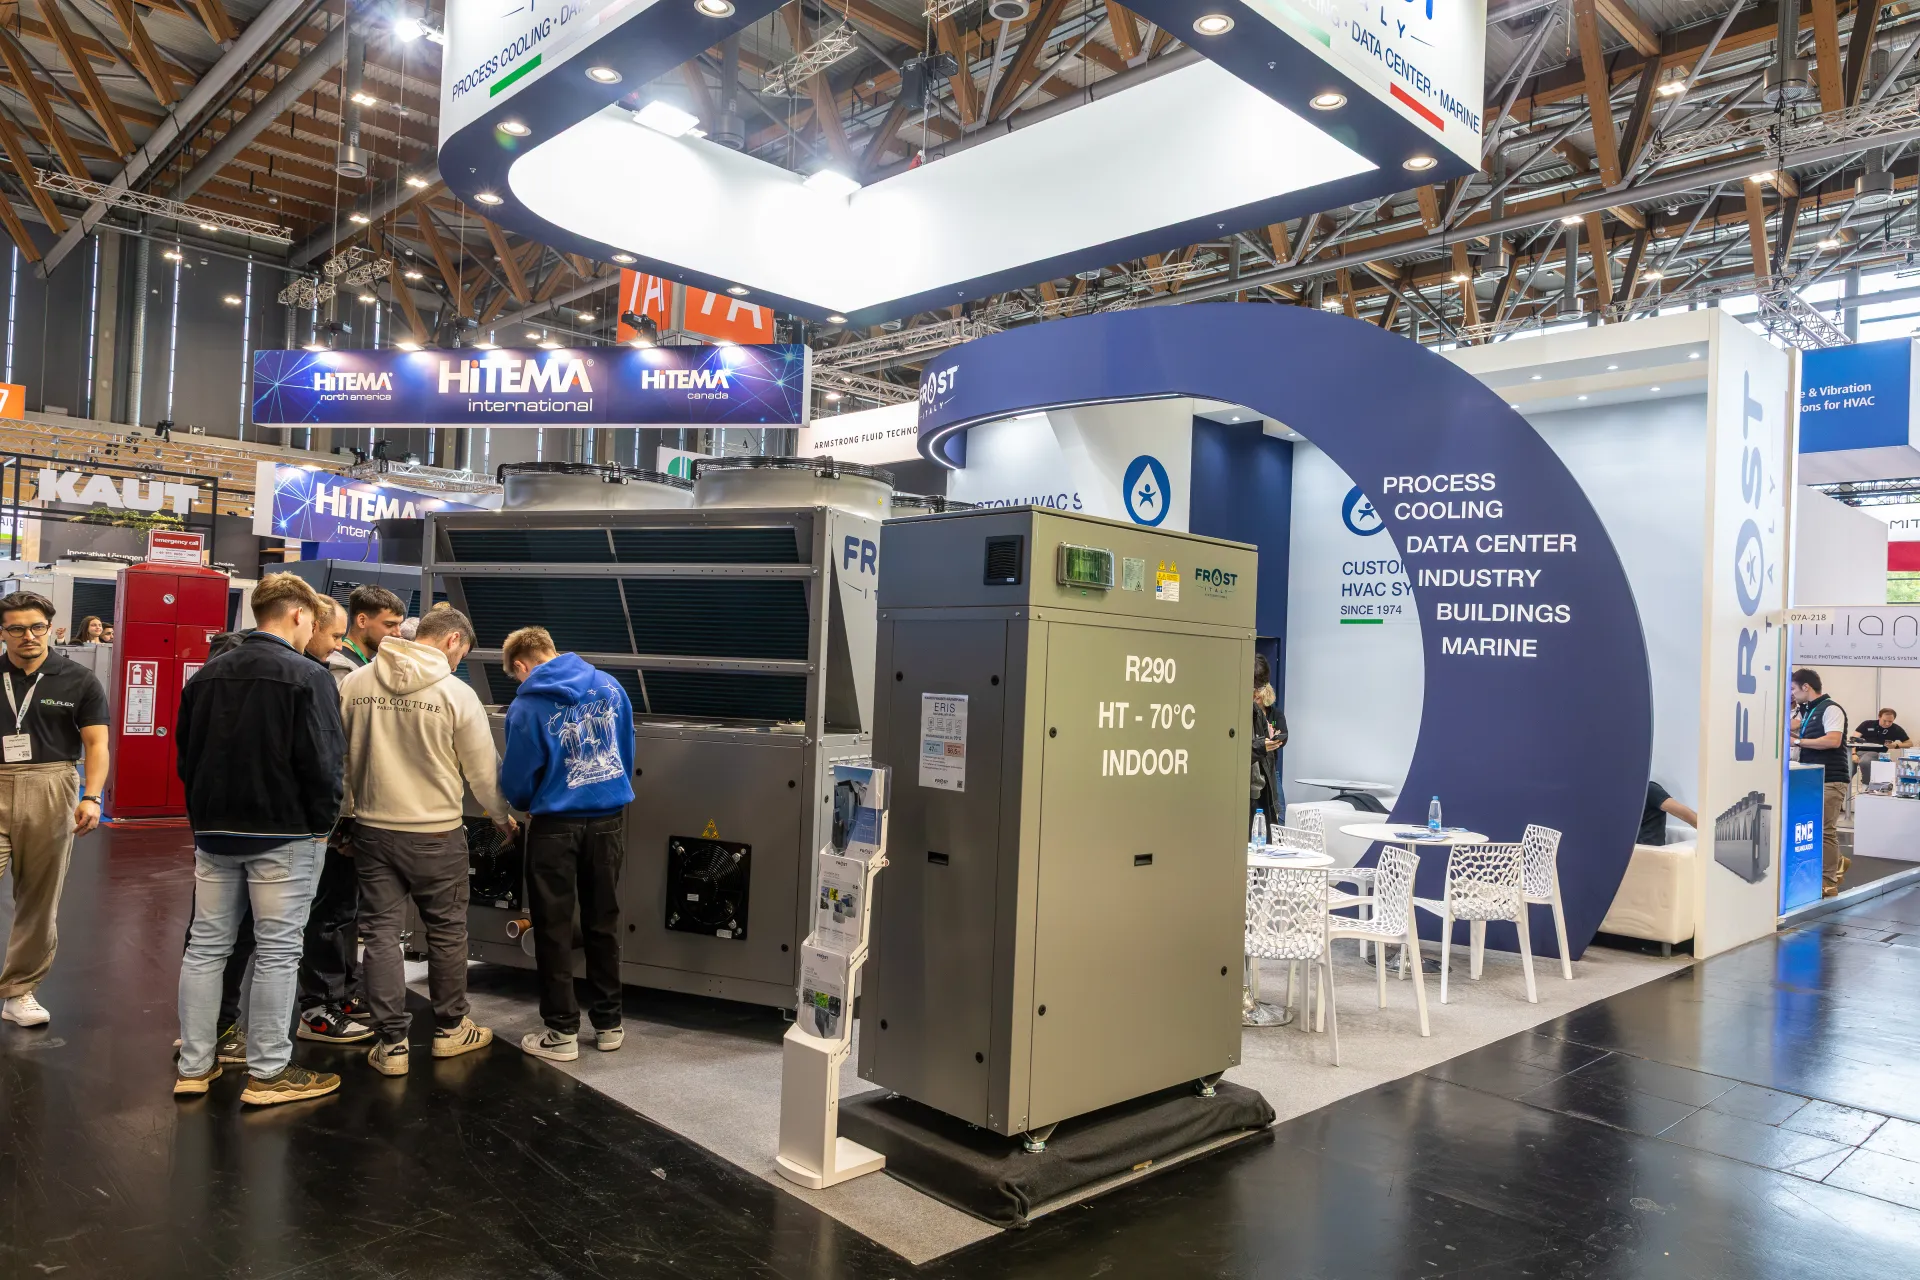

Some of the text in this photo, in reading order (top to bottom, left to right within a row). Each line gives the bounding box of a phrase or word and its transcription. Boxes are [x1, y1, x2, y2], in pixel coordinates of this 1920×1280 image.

[452, 56, 498, 102] PROCESS
[500, 17, 550, 67] COOLING
[1352, 20, 1382, 61] DATA
[1385, 48, 1431, 97] CENTER
[1440, 89, 1480, 134] MARINE
[321, 392, 391, 401] north america
[687, 391, 729, 400] canada
[1808, 388, 1817, 398] &
[1819, 383, 1872, 397] Vibration
[468, 398, 593, 412] international
[1824, 400, 1841, 411] for
[1843, 396, 1875, 409] HVAC
[814, 434, 859, 449] ARMSTRONG
[862, 431, 884, 443] FLUID
[38, 468, 199, 515] KAUT
[1383, 472, 1496, 494] PROCESS
[1394, 500, 1503, 520] COOLING
[154, 537, 188, 546] emergency
[1406, 534, 1577, 553] DATA CENTER
[1734, 369, 1765, 762] FROST
[1194, 567, 1238, 587] FROST
[1418, 569, 1542, 588] INDUSTRY
[1341, 582, 1386, 597] HVAC
[1340, 605, 1402, 615] SINCE 1974
[1437, 602, 1571, 624] BUILDINGS
[1441, 636, 1538, 658] MARINE
[1125, 655, 1176, 684] R290
[389, 698, 441, 713] COUTURE
[934, 702, 956, 714] ERIS
[1098, 702, 1129, 729] HT
[1150, 703, 1196, 730] 70°C
[1102, 748, 1189, 776] INDOOR
